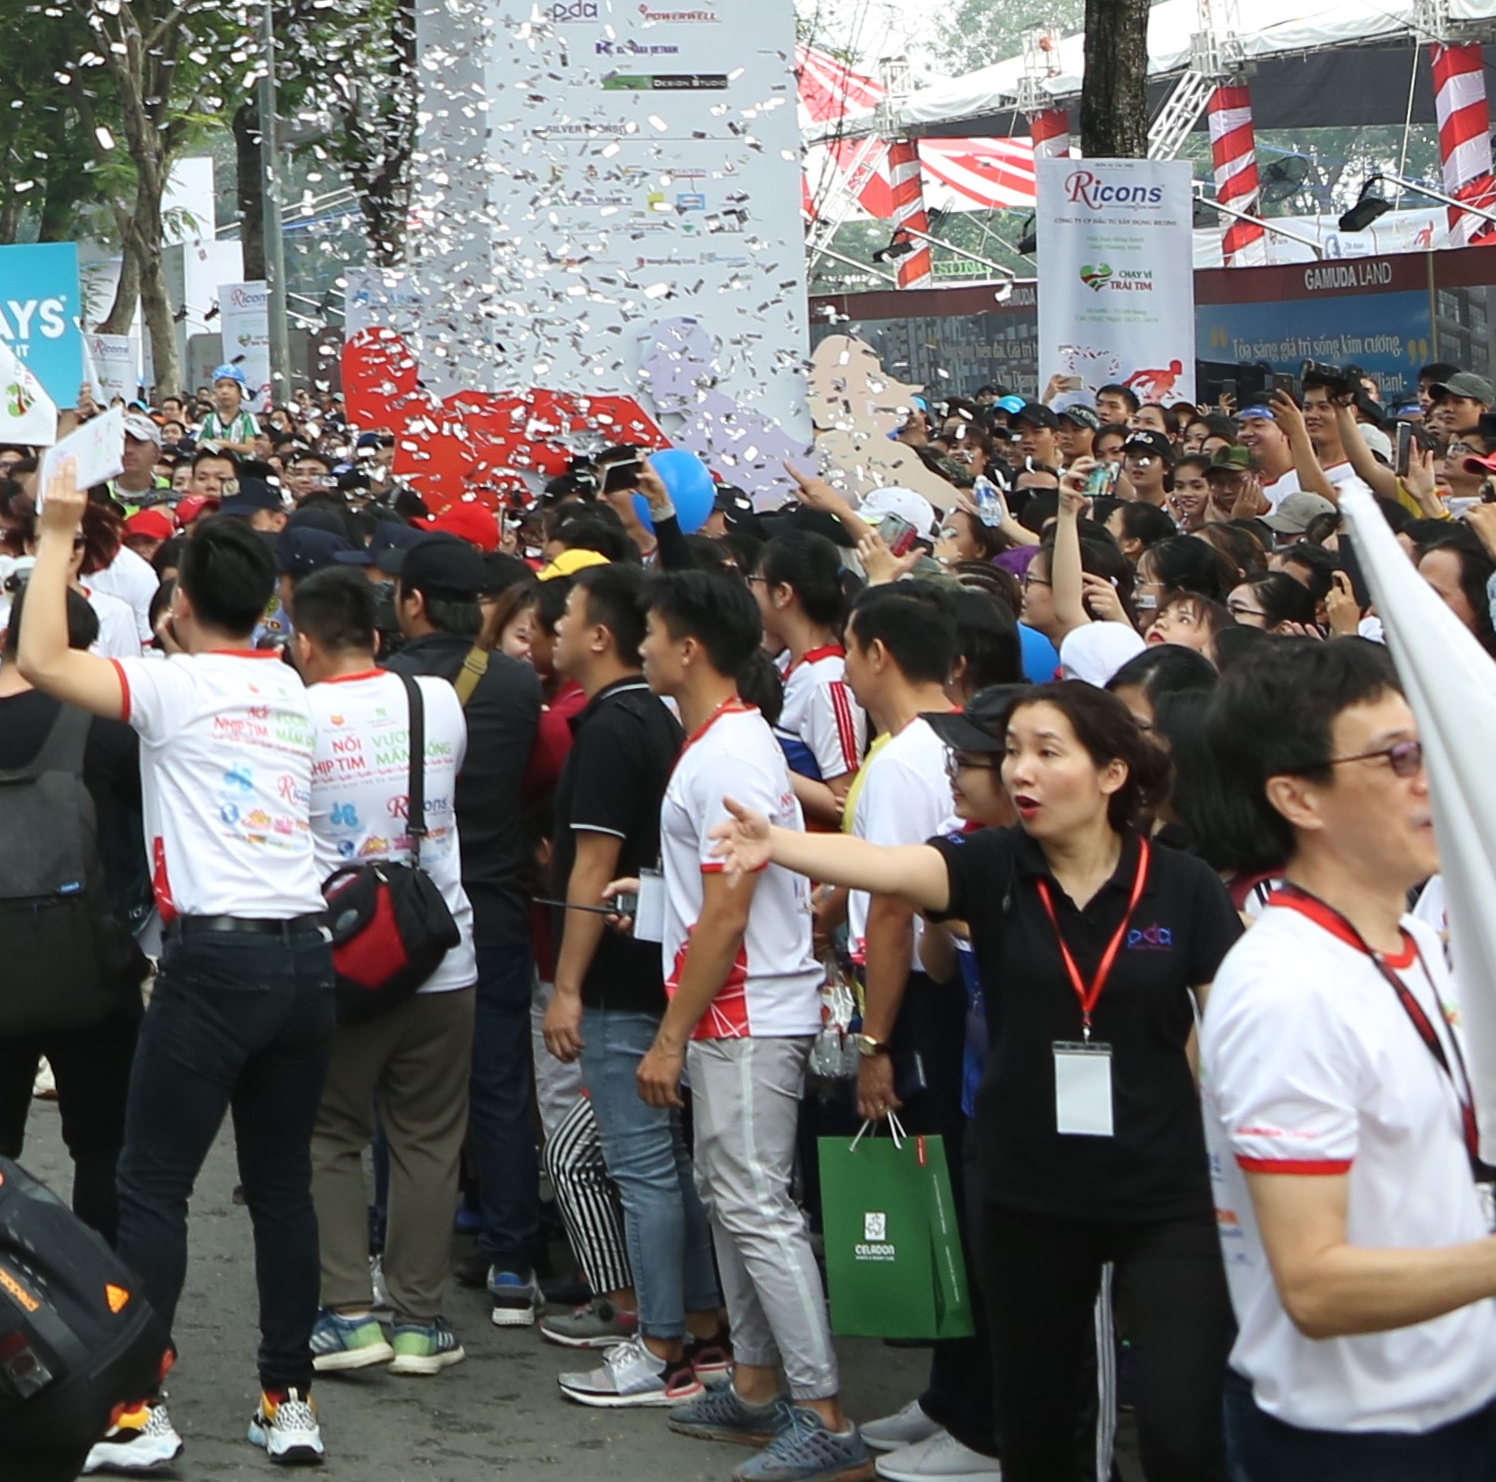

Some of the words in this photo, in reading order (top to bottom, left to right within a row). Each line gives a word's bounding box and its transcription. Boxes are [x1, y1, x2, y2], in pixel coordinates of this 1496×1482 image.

[1064, 170, 1163, 211] Ricons
[1304, 266, 1358, 291] GAMUDA
[1358, 261, 1393, 287] LAND
[1135, 281, 1153, 292] TIM
[231, 288, 268, 307] Ricon
[1342, 333, 1362, 355] kim
[331, 734, 363, 755] NỐI
[370, 729, 410, 749] VƯƠ
[423, 740, 452, 758] ỐNG
[337, 757, 366, 774] TIM
[854, 1244, 895, 1256] CELADON
